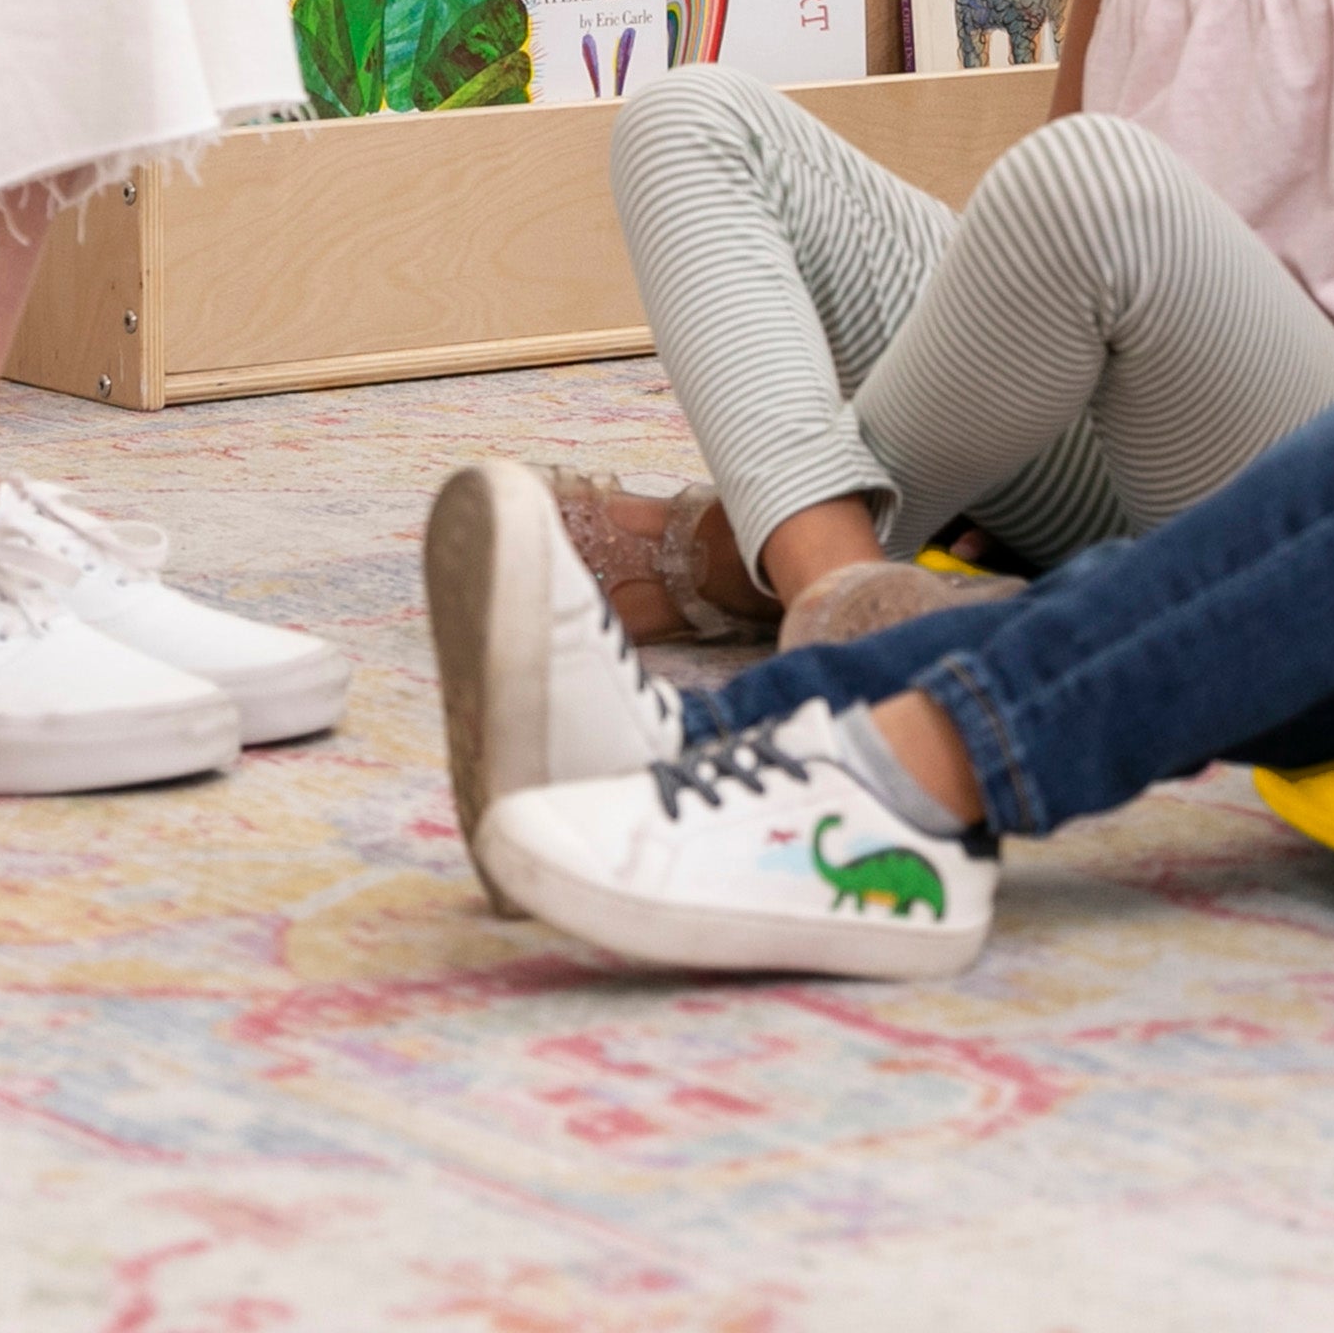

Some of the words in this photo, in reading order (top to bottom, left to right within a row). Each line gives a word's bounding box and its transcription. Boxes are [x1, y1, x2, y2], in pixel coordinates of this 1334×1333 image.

[579, 14, 594, 30] by
[596, 13, 620, 28] Eric
[622, 10, 653, 27] Carle
